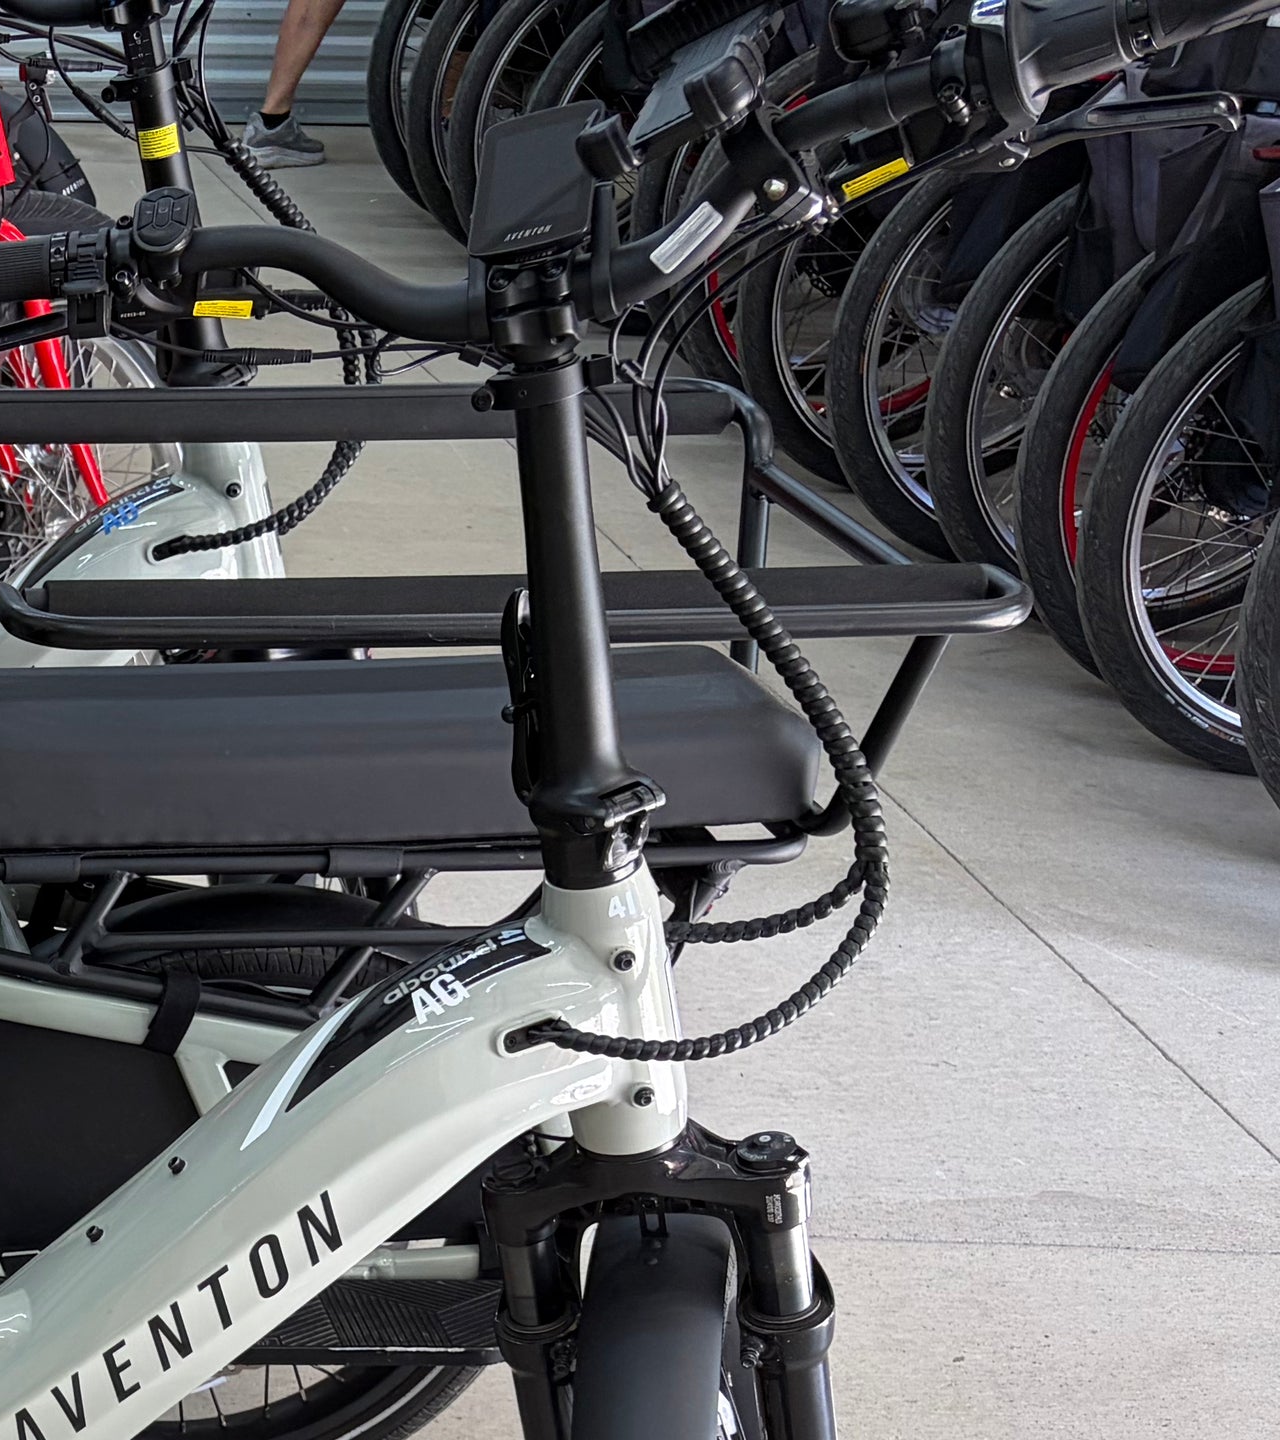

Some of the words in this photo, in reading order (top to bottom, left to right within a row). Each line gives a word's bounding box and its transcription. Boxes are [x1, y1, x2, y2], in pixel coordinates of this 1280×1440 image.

[503, 223, 553, 242] AVENTON
[74, 485, 151, 534] abound
[608, 890, 637, 919] 41
[383, 938, 498, 1005] abound
[411, 973, 470, 1025] AG
